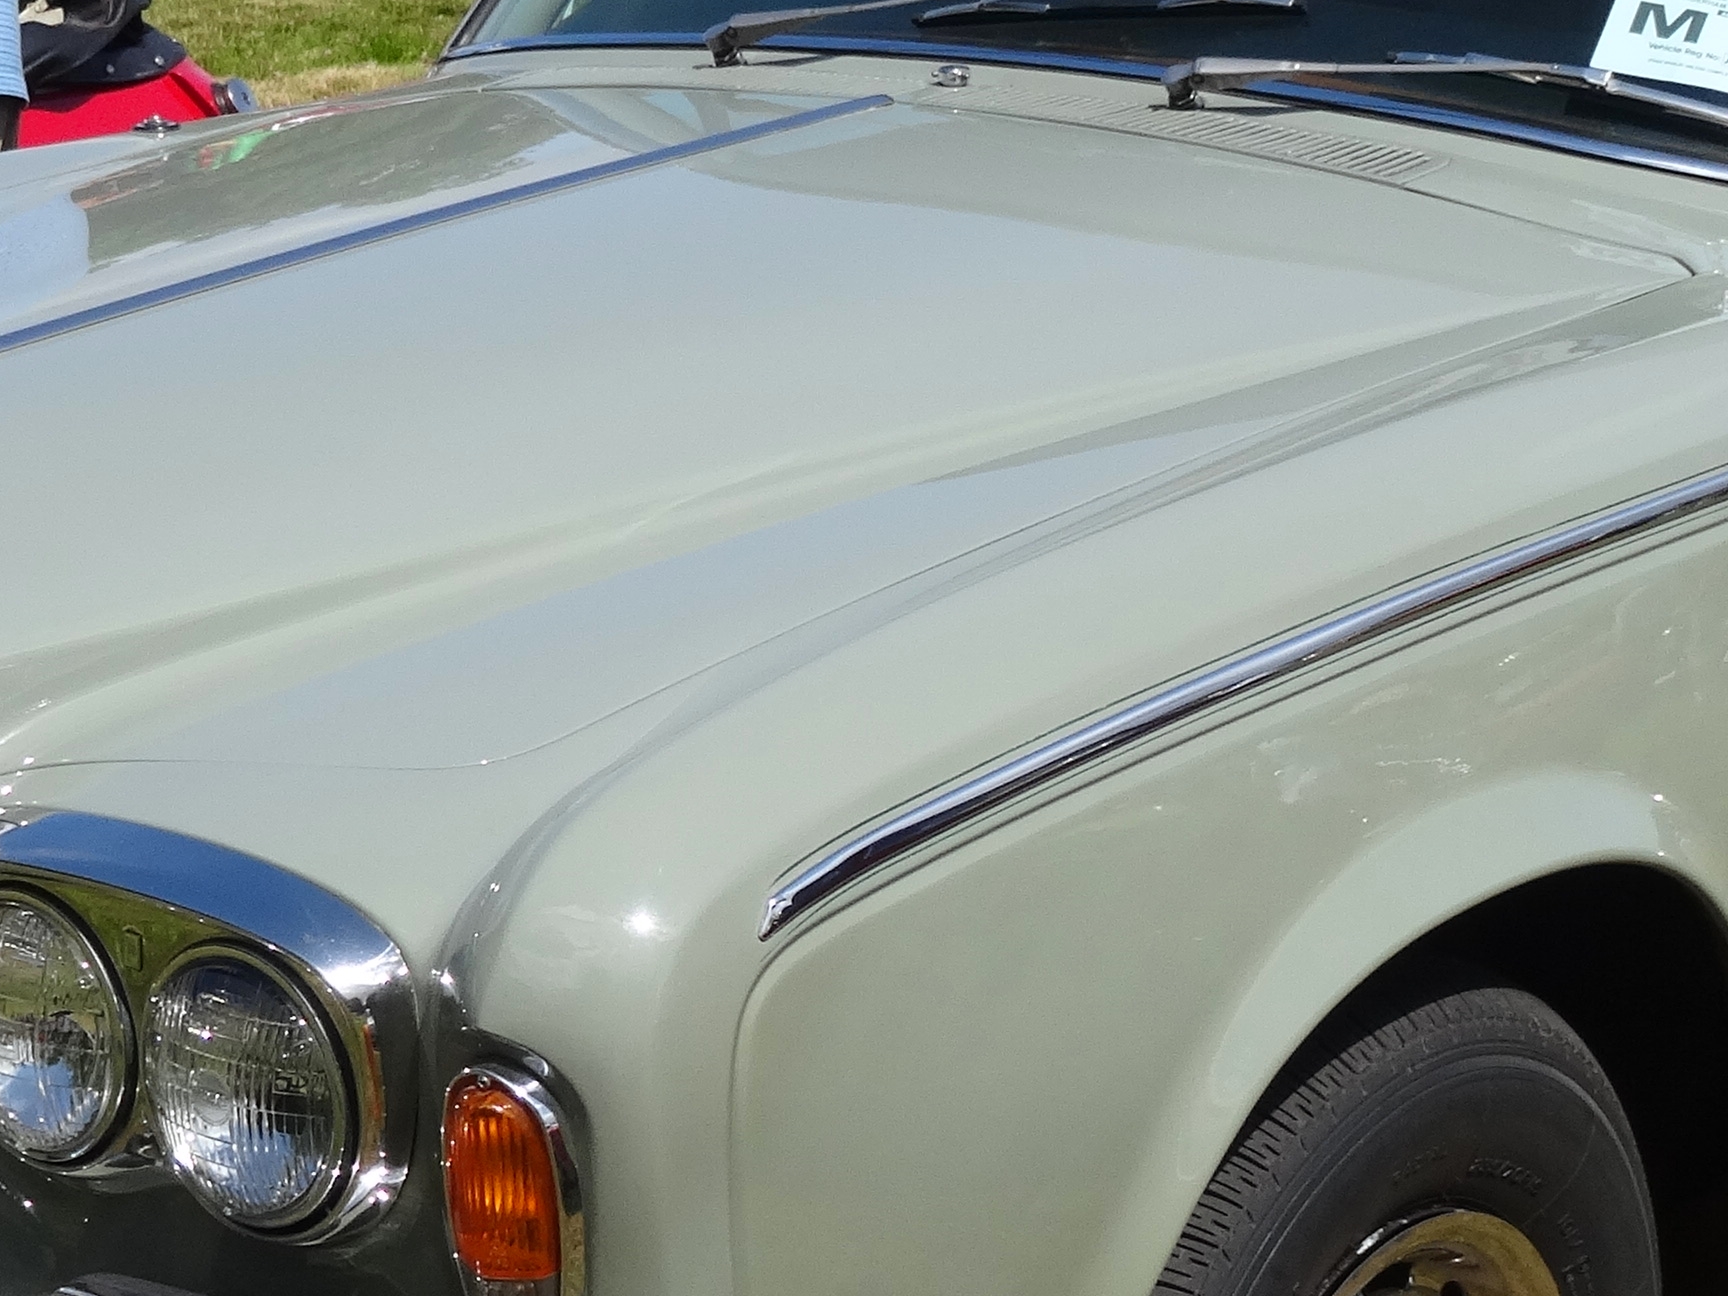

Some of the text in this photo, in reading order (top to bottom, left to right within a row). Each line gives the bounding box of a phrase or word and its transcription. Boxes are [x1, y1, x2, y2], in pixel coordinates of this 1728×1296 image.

[1628, 1, 1710, 45] M
[1648, 42, 1683, 54] Vehicle
[1684, 48, 1704, 59] Reg
